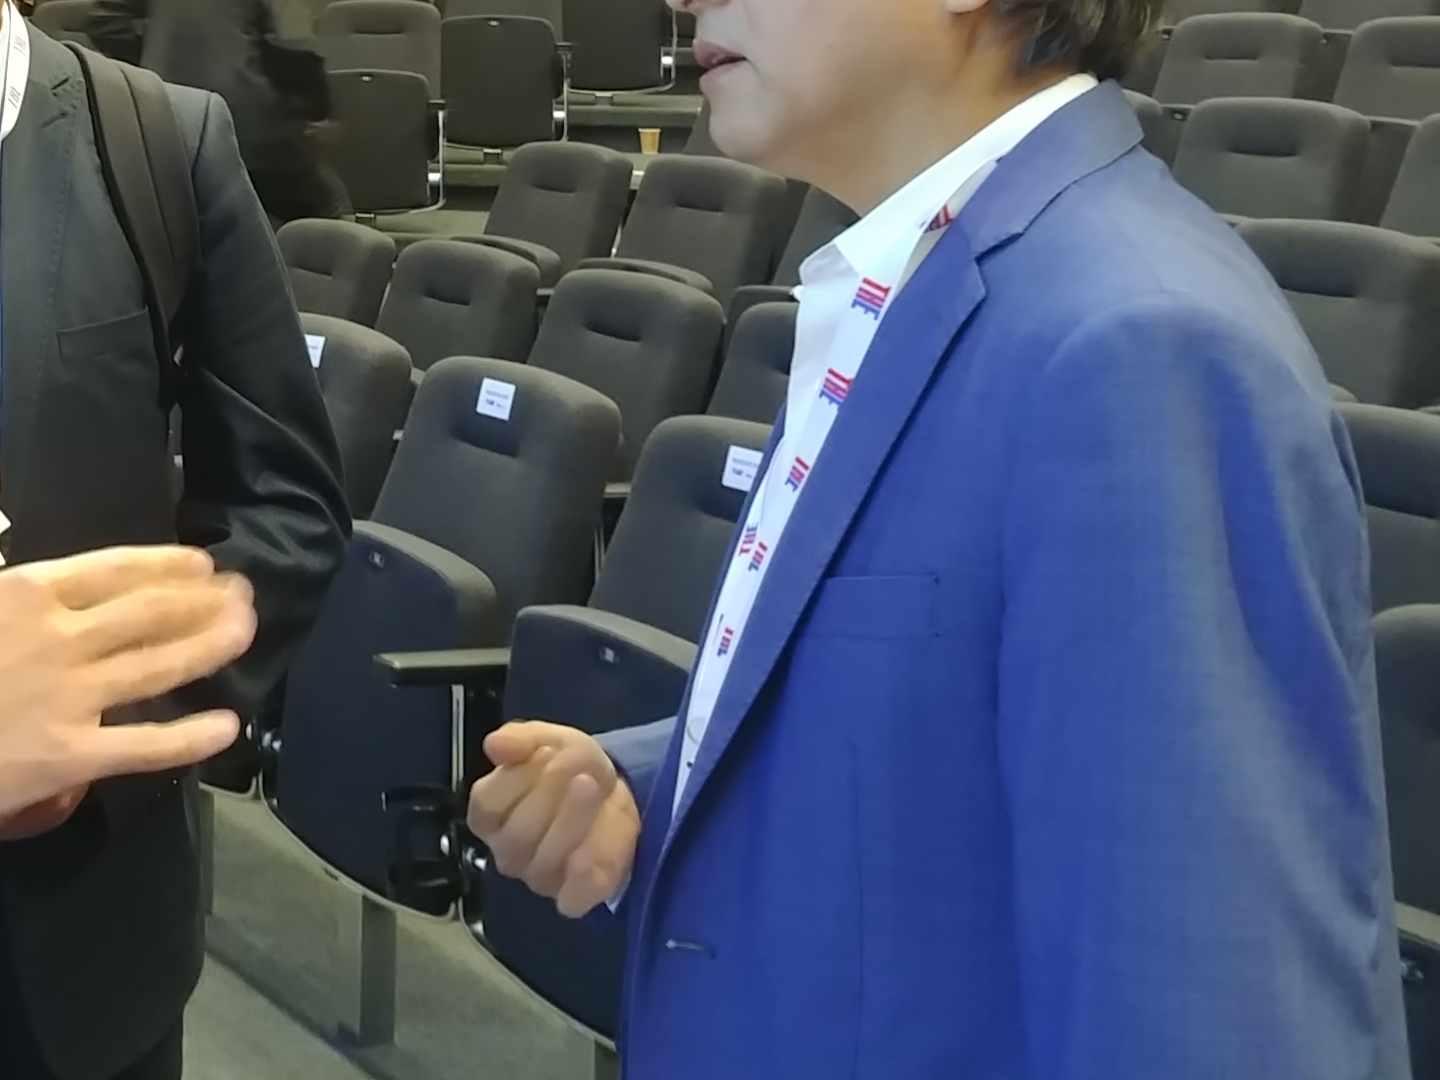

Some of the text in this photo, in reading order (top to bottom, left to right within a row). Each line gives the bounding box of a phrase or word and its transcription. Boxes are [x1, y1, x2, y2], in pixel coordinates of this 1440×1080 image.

[851, 277, 891, 320] THE
[819, 368, 853, 406] THE
[739, 523, 757, 556] THE
